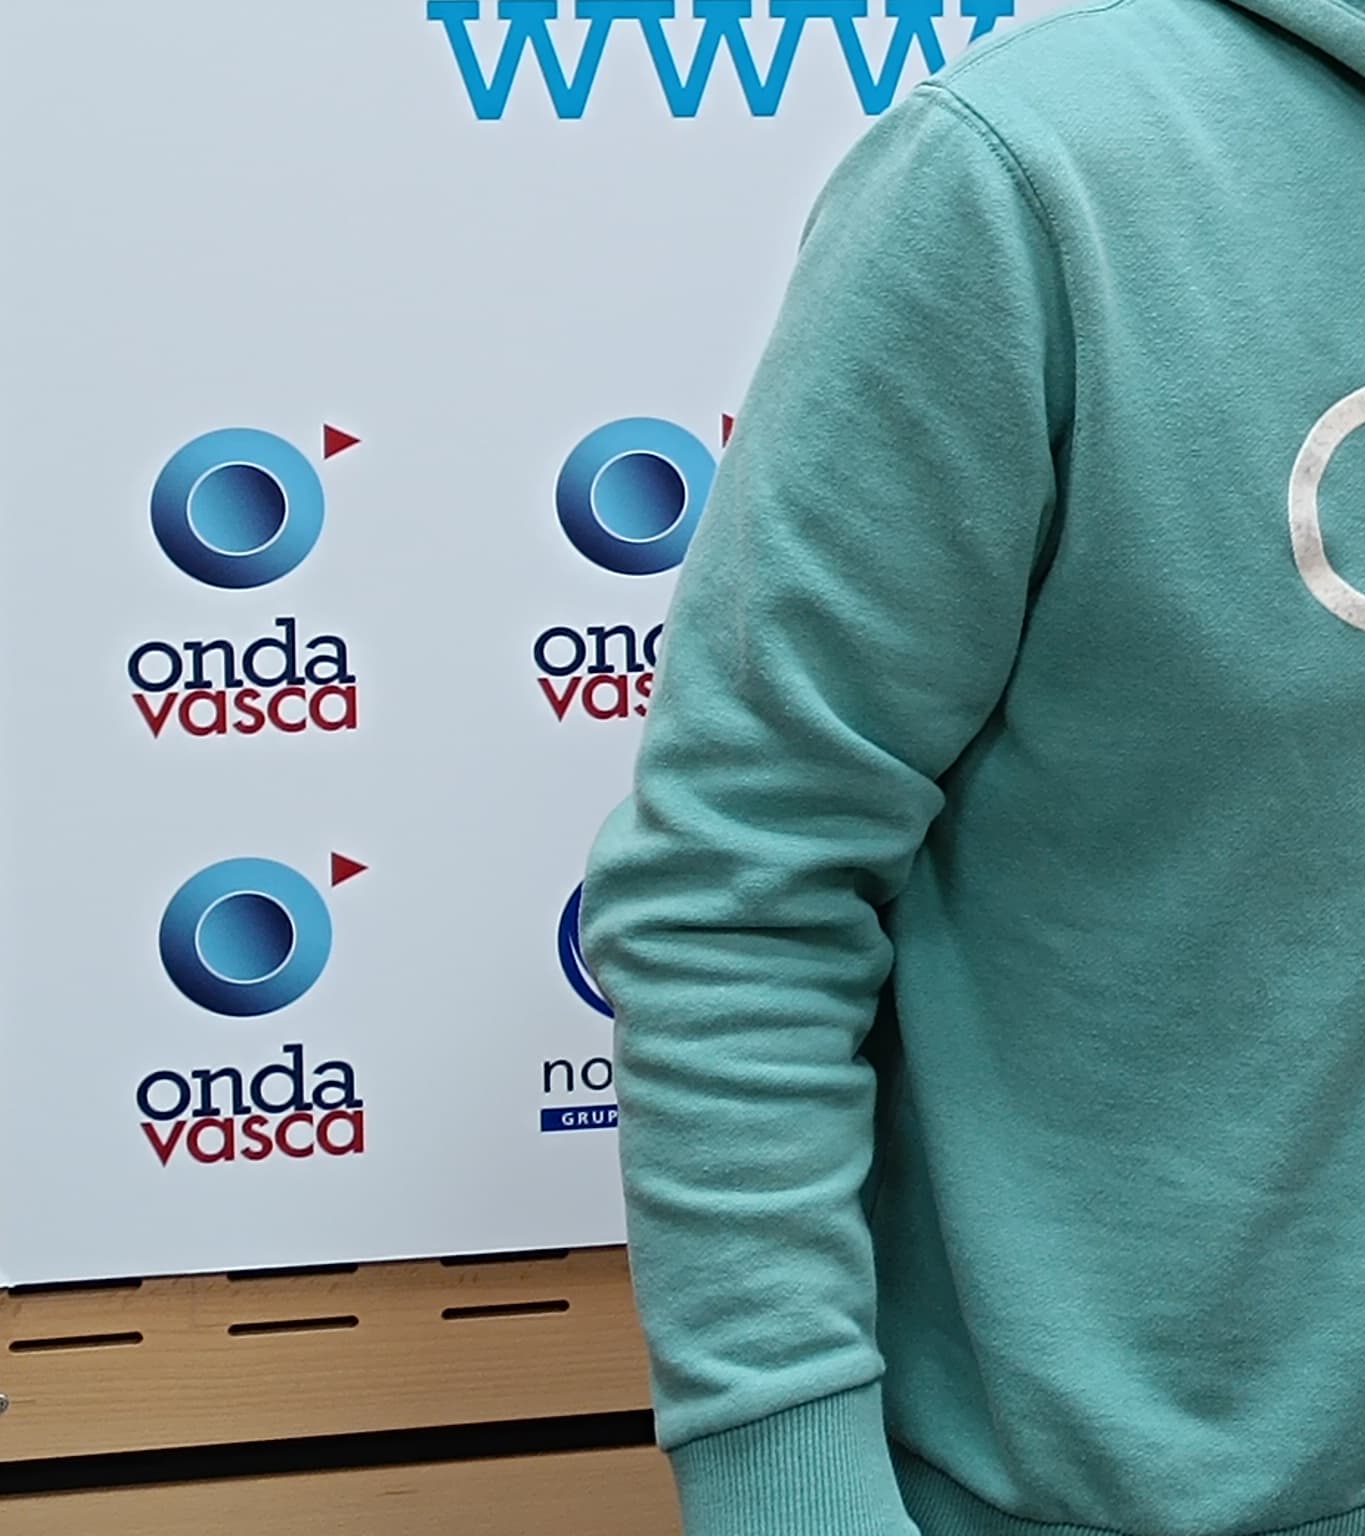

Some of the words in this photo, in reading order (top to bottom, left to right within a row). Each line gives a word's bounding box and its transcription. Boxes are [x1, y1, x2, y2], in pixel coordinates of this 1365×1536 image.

[127, 617, 356, 692] onda
[131, 685, 358, 739] vasca
[136, 1043, 364, 1121] onda
[140, 1109, 364, 1168] vasca
